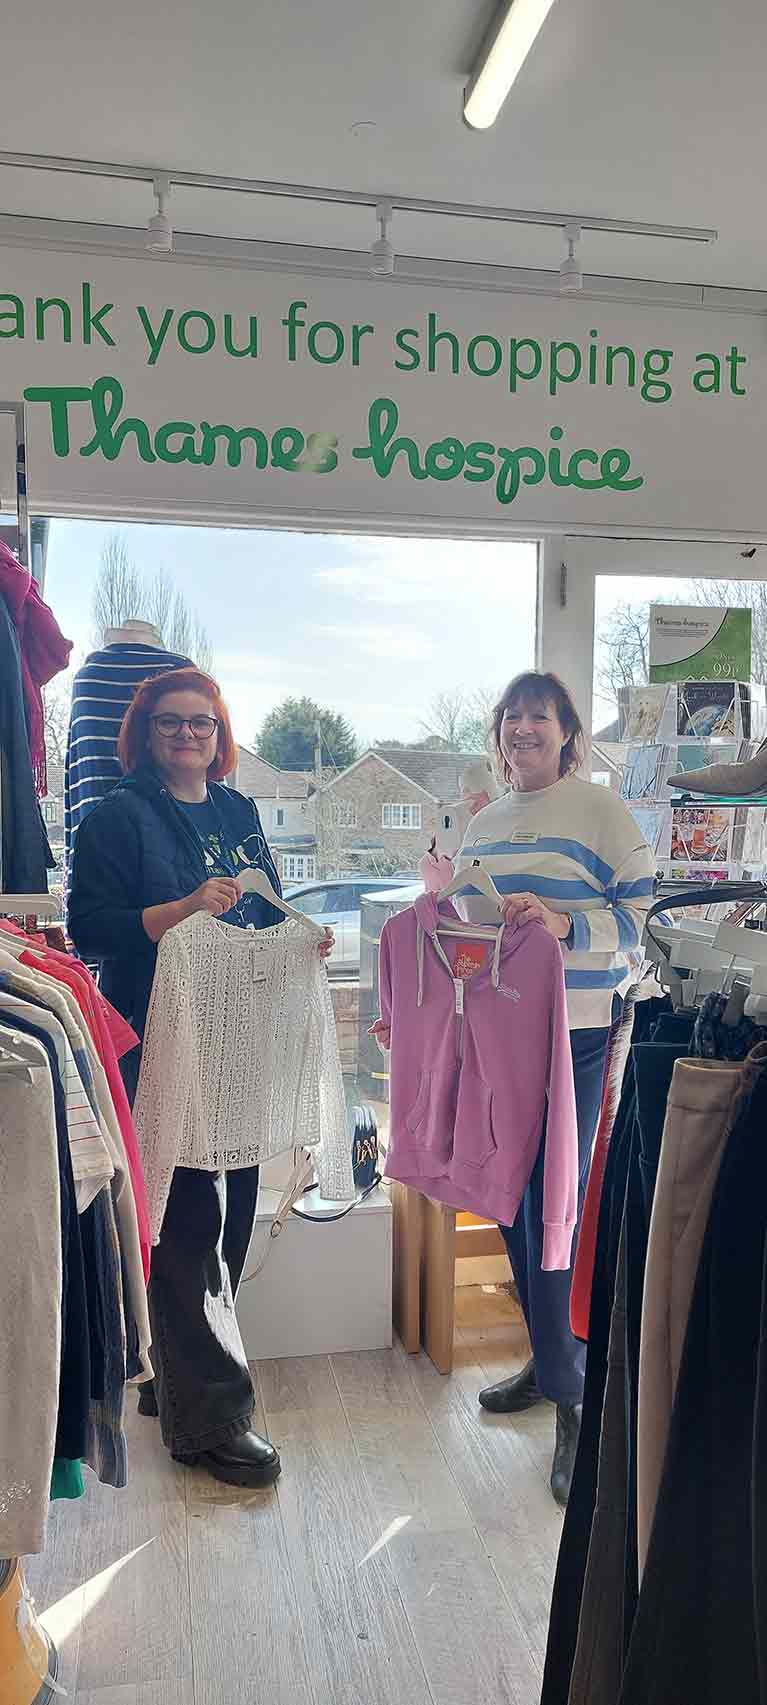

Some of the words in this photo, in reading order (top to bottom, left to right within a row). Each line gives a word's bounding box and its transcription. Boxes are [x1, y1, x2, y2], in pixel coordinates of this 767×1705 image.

[137, 304, 260, 365] you
[281, 300, 374, 367] for
[394, 313, 673, 403] shopping
[691, 345, 747, 397] at
[22, 376, 339, 474] Thames
[351, 398, 645, 505] hospice
